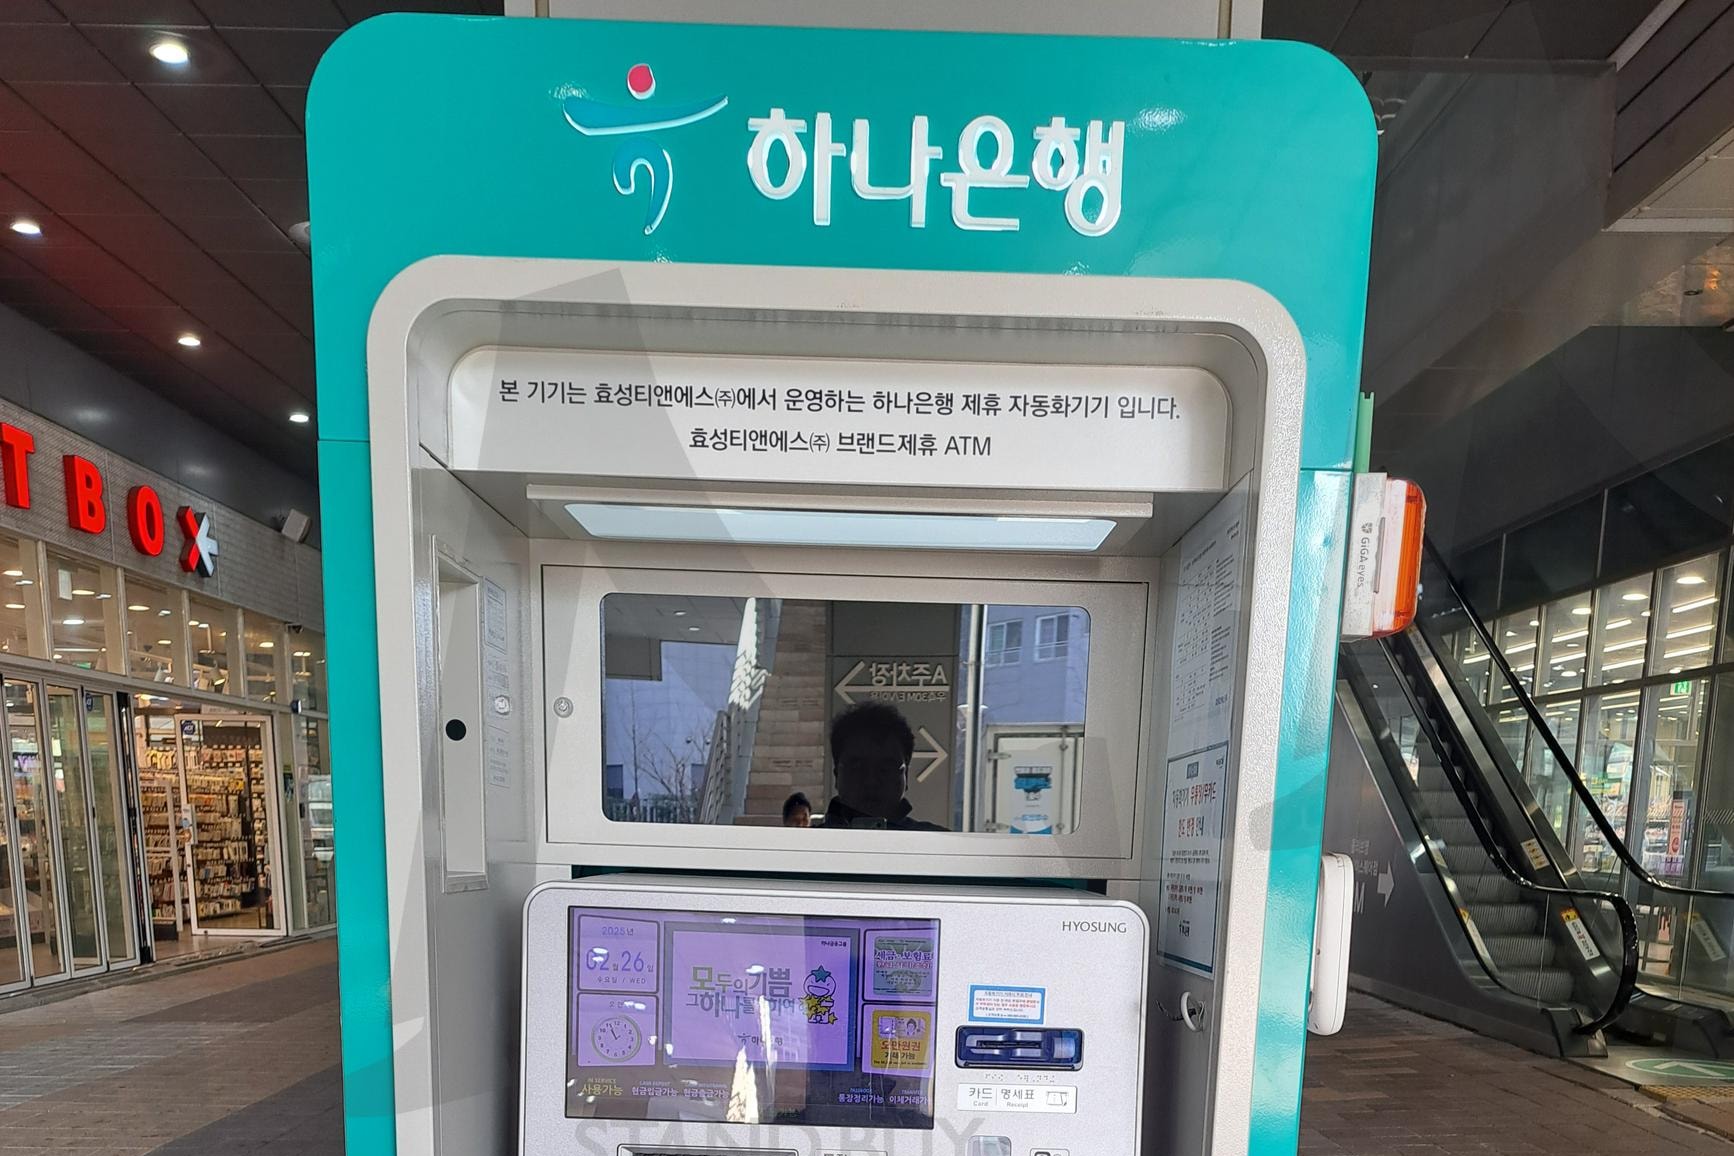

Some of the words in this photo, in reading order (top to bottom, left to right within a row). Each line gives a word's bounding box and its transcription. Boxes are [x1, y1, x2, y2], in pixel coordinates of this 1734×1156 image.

[747, 108, 1125, 237] 하나은행
[499, 380, 520, 402] 본
[527, 381, 587, 405] 기기는
[784, 387, 866, 412] 운영하는
[873, 390, 954, 415] 하나은행
[961, 393, 1002, 416] 제휴
[1008, 394, 1109, 418] 자동화기기
[1117, 396, 1180, 419] 입니다.
[836, 432, 938, 456] 브랜드제휴
[944, 436, 992, 456] ATM
[602, 926, 634, 936] 2025년
[1061, 920, 1127, 934] HYOSUNG
[582, 1083, 623, 1096] 사용가능
[969, 1088, 992, 1099] 카드
[1001, 1088, 1035, 1100] 명세표
